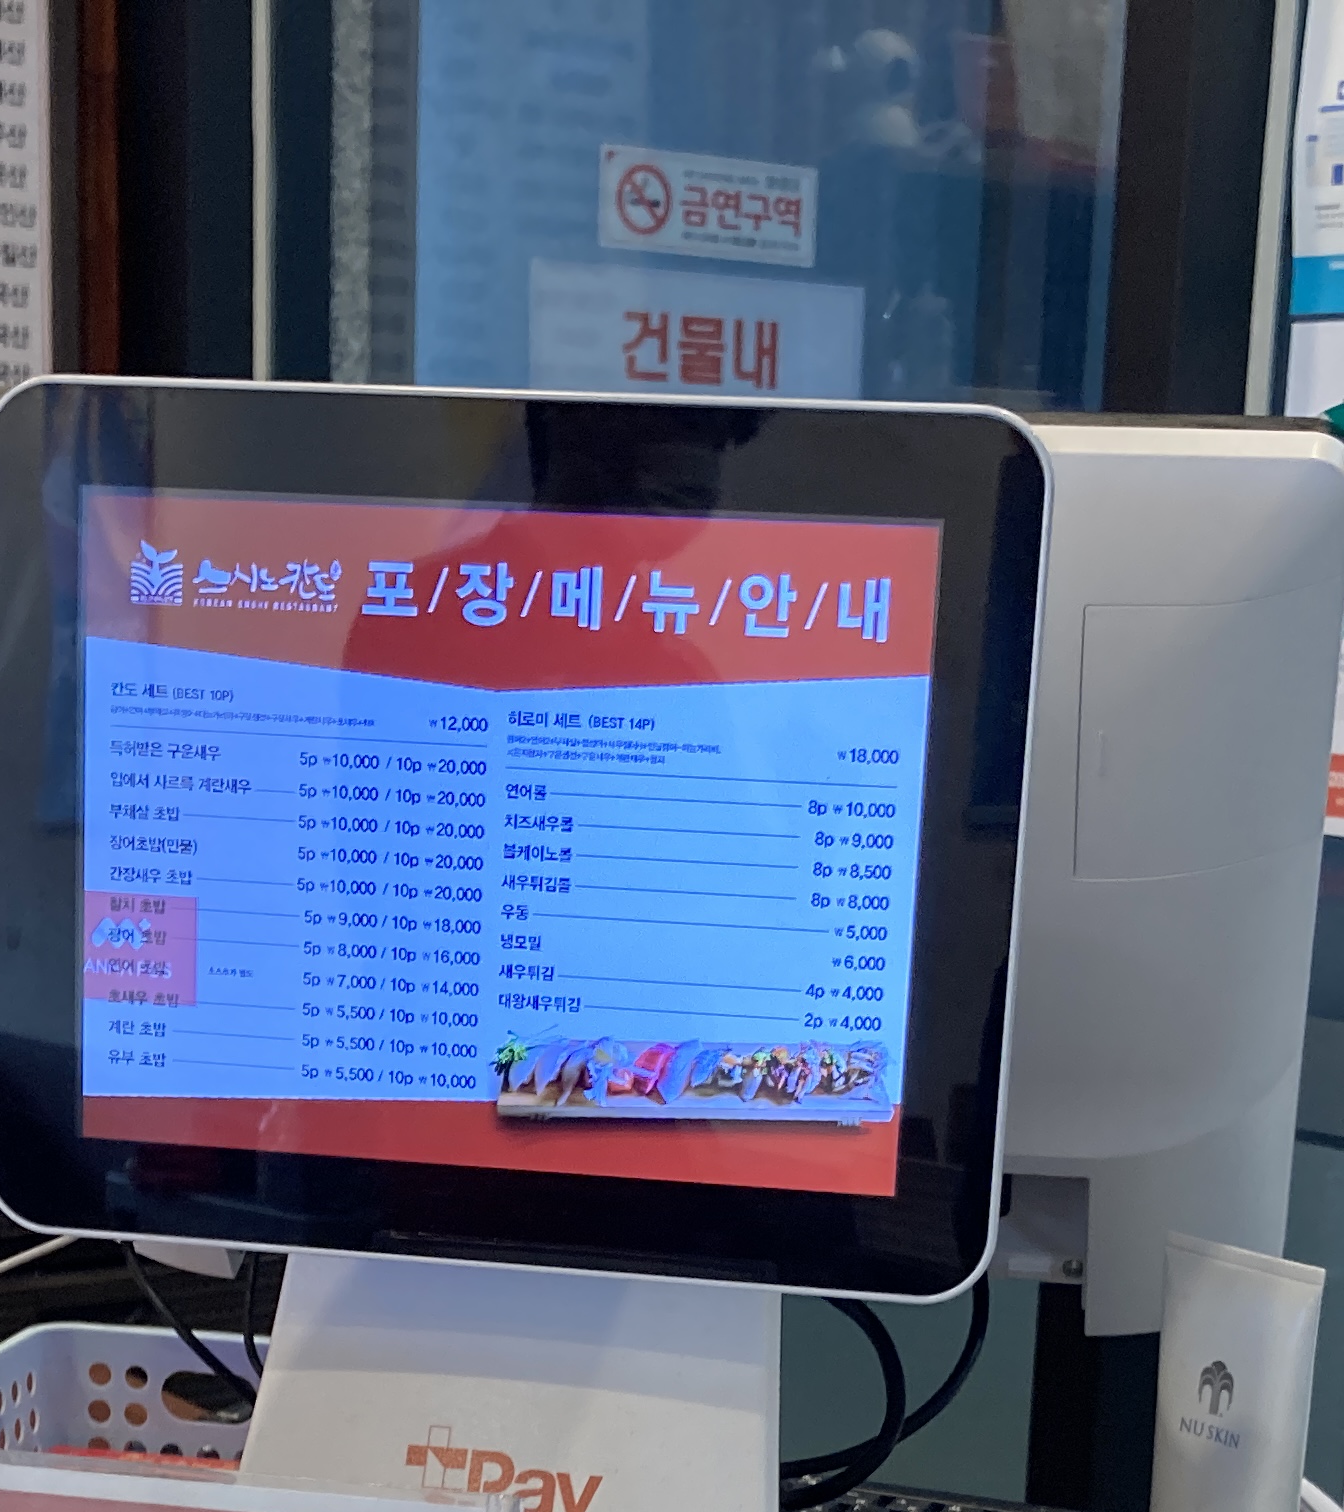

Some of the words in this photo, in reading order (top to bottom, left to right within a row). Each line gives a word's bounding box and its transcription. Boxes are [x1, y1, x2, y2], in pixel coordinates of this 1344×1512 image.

[679, 184, 801, 237] 금연구역
[622, 310, 779, 390] 건물내
[110, 682, 138, 698] 칸도
[142, 683, 169, 699] 세트
[554, 712, 582, 729] 세트
[167, 743, 221, 761] 구운새우
[110, 771, 150, 789] 입에서
[505, 783, 547, 801] 연어롤
[108, 804, 149, 821] 부채살
[153, 806, 180, 822] 초밥
[504, 814, 574, 834] 치즈새우롤
[109, 866, 162, 884] 간장새우
[166, 868, 193, 886] 초밥
[501, 875, 571, 893] 새우튀김롤
[500, 904, 529, 921] 우동
[500, 934, 541, 952] 냉모밀
[499, 965, 554, 983] 새우튀김
[498, 993, 581, 1014] 대왕새우튀김
[108, 1019, 136, 1036] 계란
[139, 1022, 166, 1039] 초밥
[107, 1050, 135, 1067] 유부
[139, 1053, 166, 1069] 초밥
[1178, 1416, 1204, 1439] NU
[1206, 1421, 1242, 1450] SKIN
